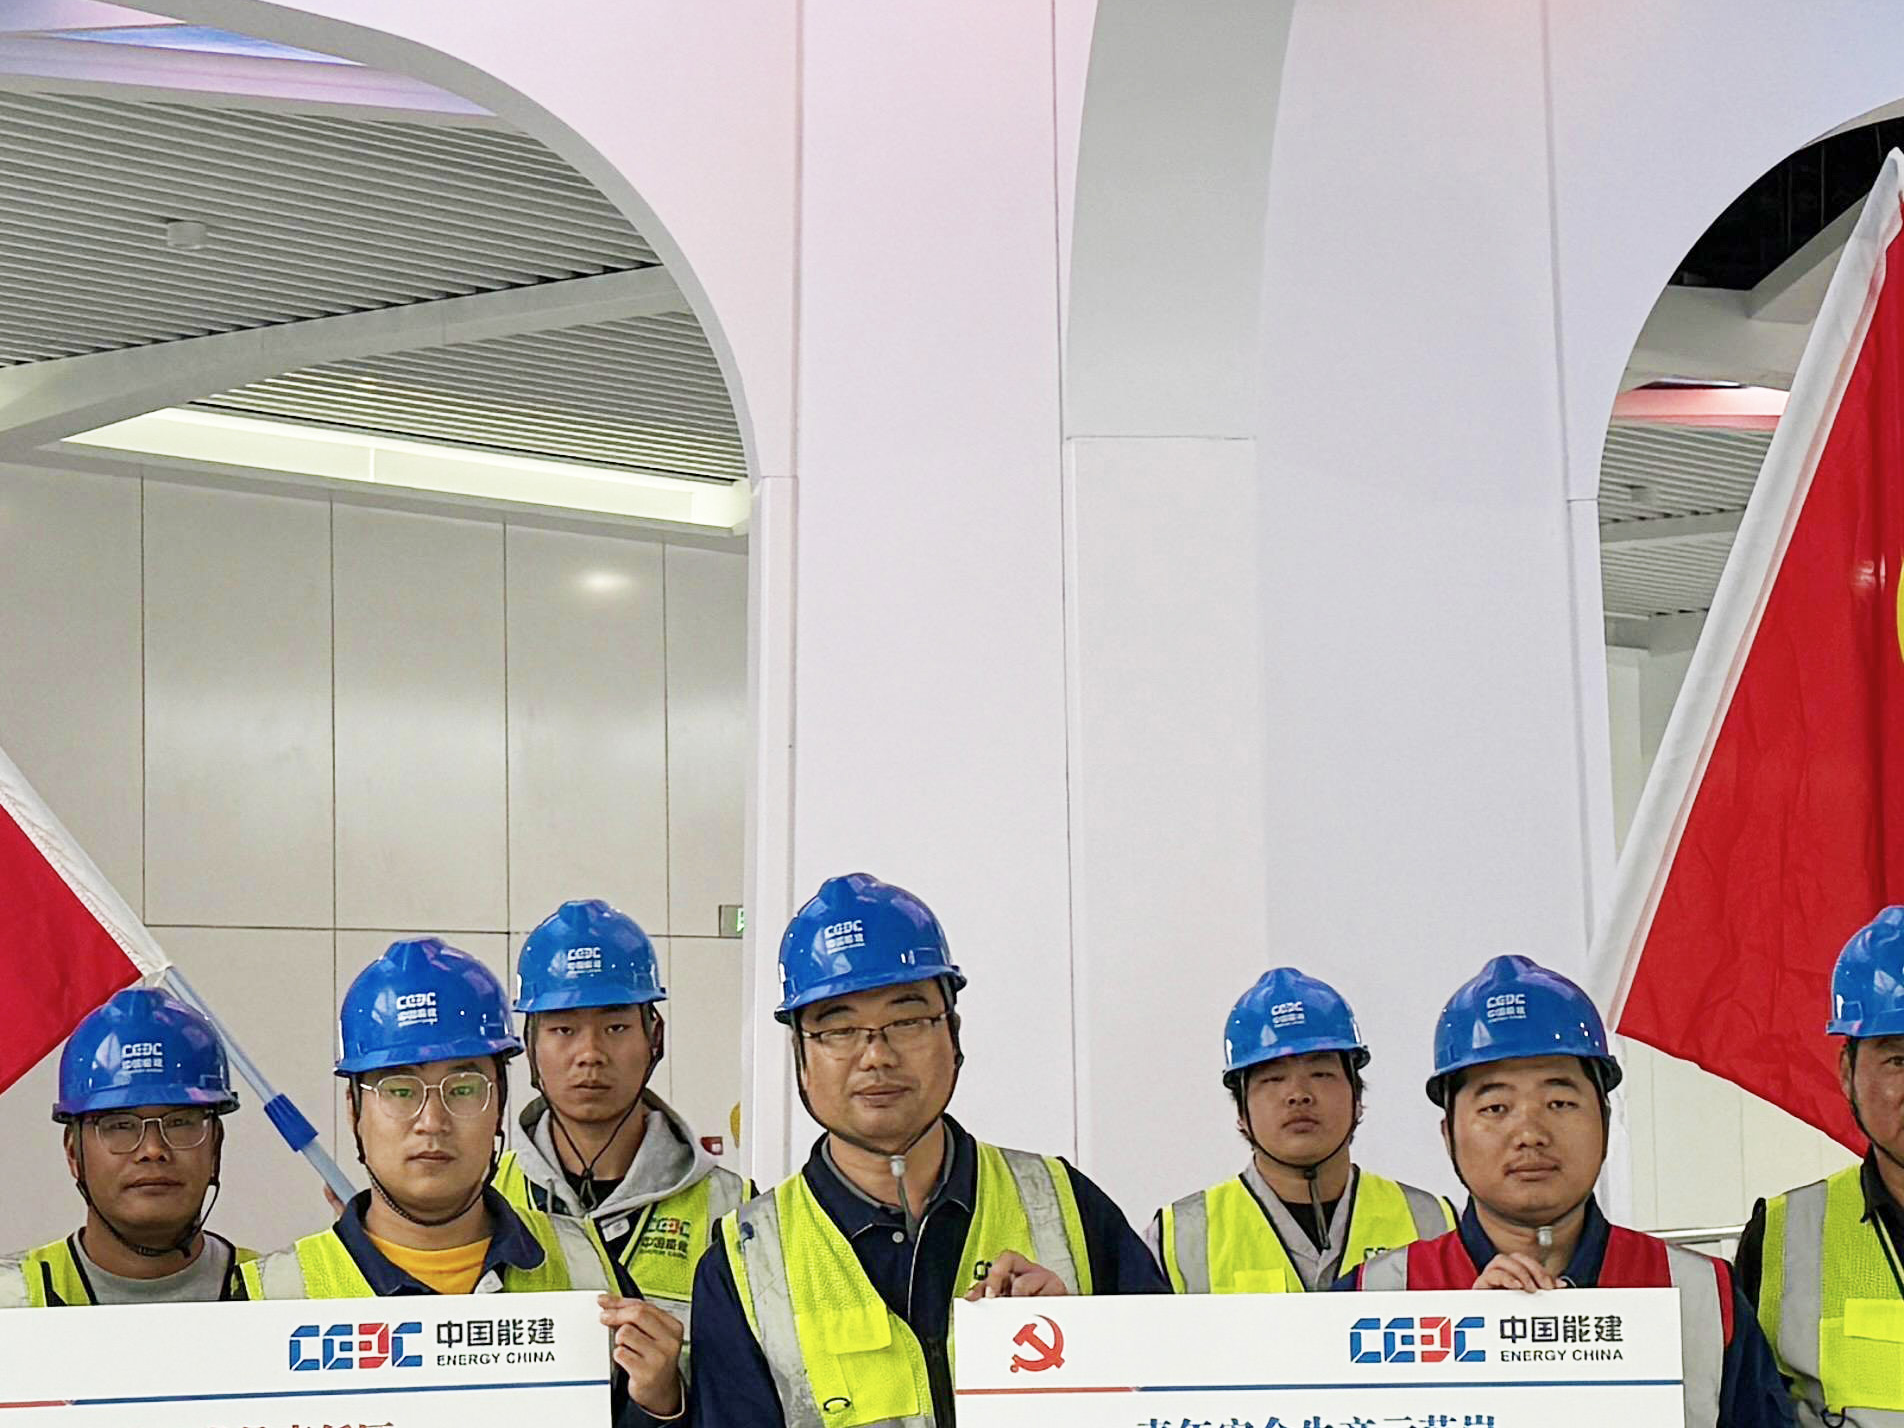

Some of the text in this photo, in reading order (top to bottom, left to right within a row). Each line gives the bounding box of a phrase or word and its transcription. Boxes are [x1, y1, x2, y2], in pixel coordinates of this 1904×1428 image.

[437, 1318, 556, 1348] 中国能建
[1500, 1314, 1624, 1344] 中国能建
[437, 1351, 556, 1367] ENERGY CHINA
[1501, 1348, 1623, 1363] ENERGY CHINA
